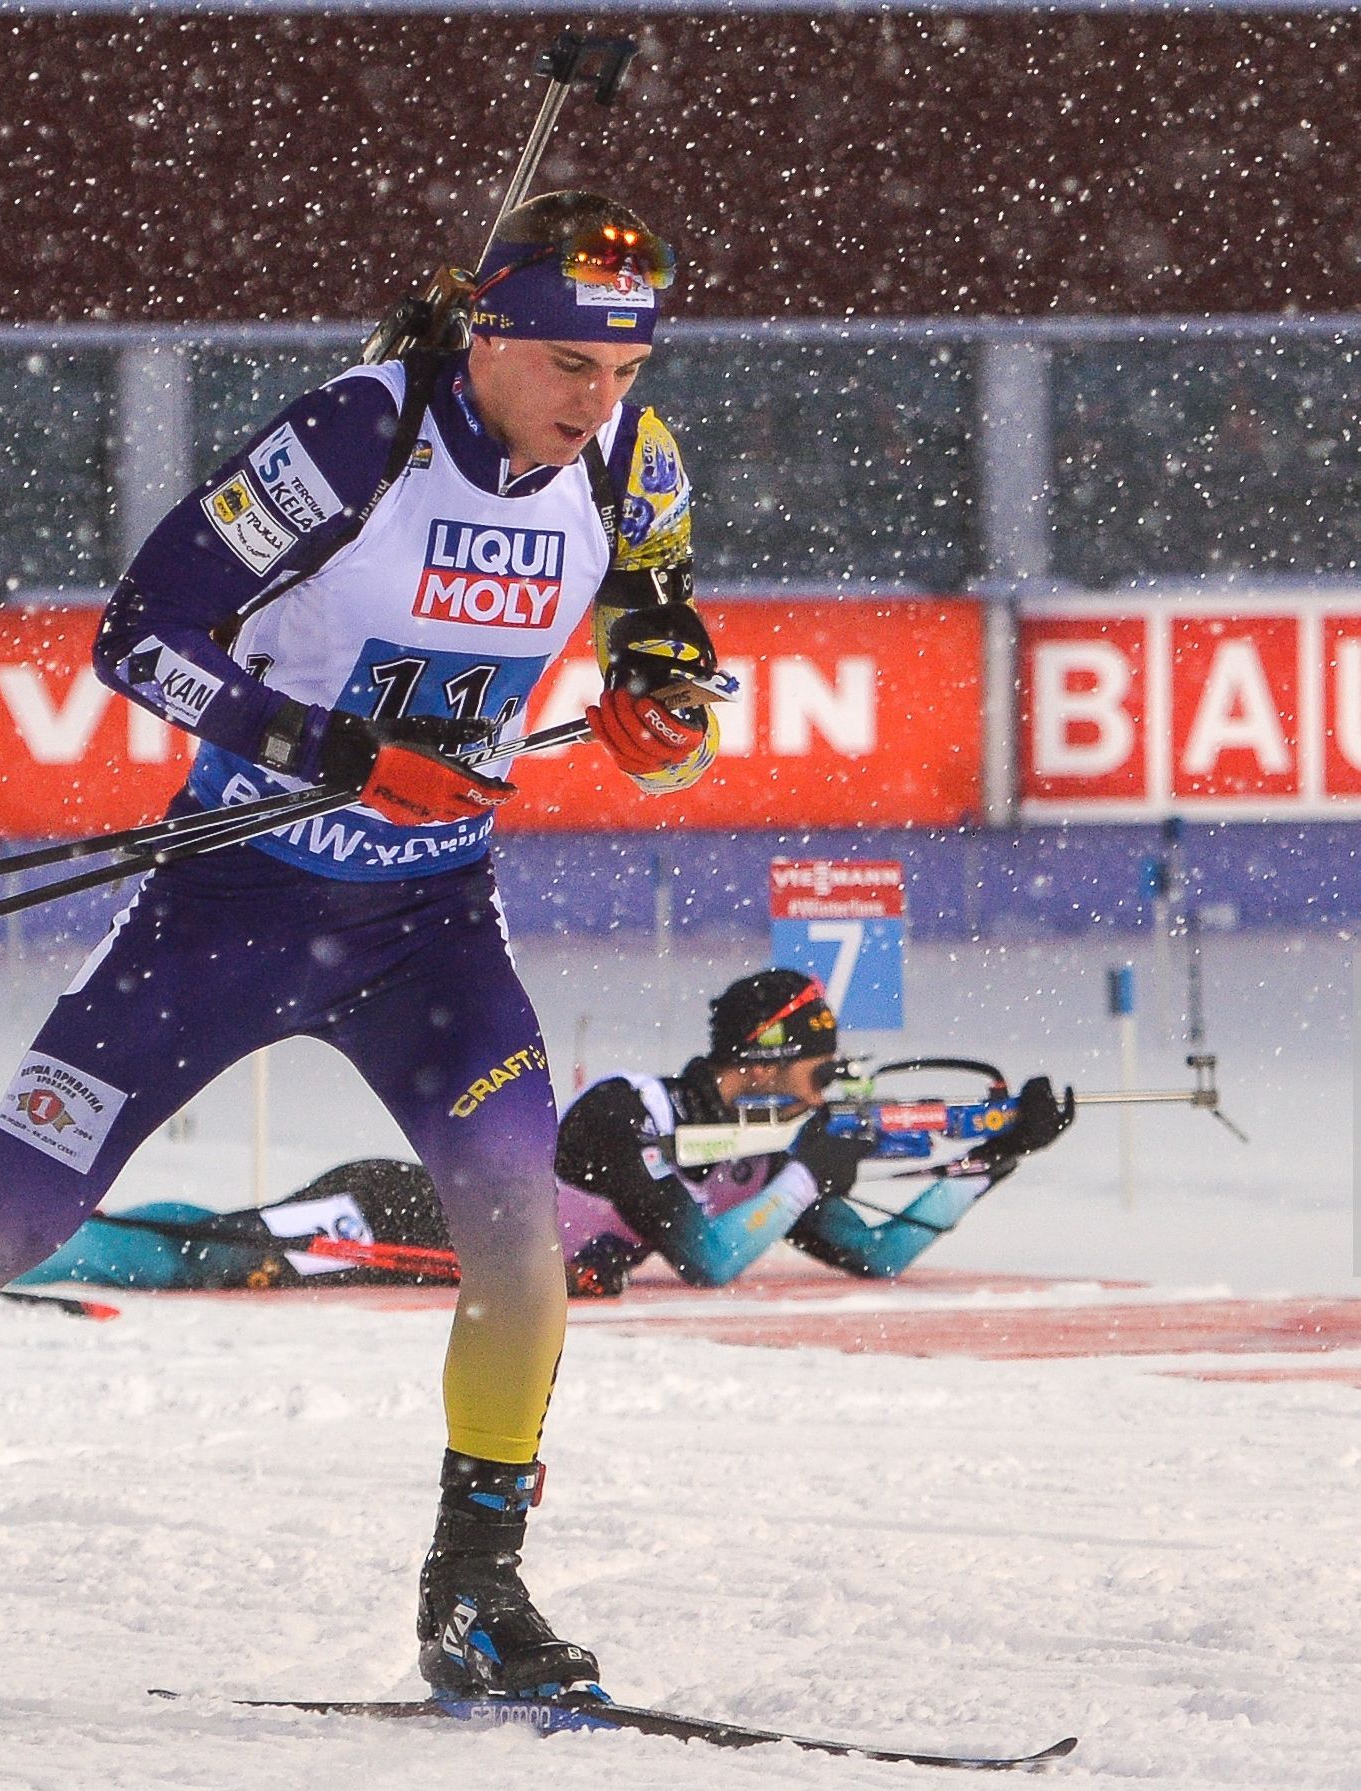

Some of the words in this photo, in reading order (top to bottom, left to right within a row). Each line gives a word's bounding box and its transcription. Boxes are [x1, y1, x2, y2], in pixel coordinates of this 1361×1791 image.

[290, 476, 327, 521] TERCIUM
[431, 524, 560, 577] LIQUI
[420, 573, 559, 625] MOLY
[162, 668, 215, 712] KAN
[1032, 639, 1361, 778] BA
[808, 921, 865, 1018] 7
[53, 1069, 104, 1114] ПРИВАТНА
[453, 1048, 534, 1118] CRAFT
